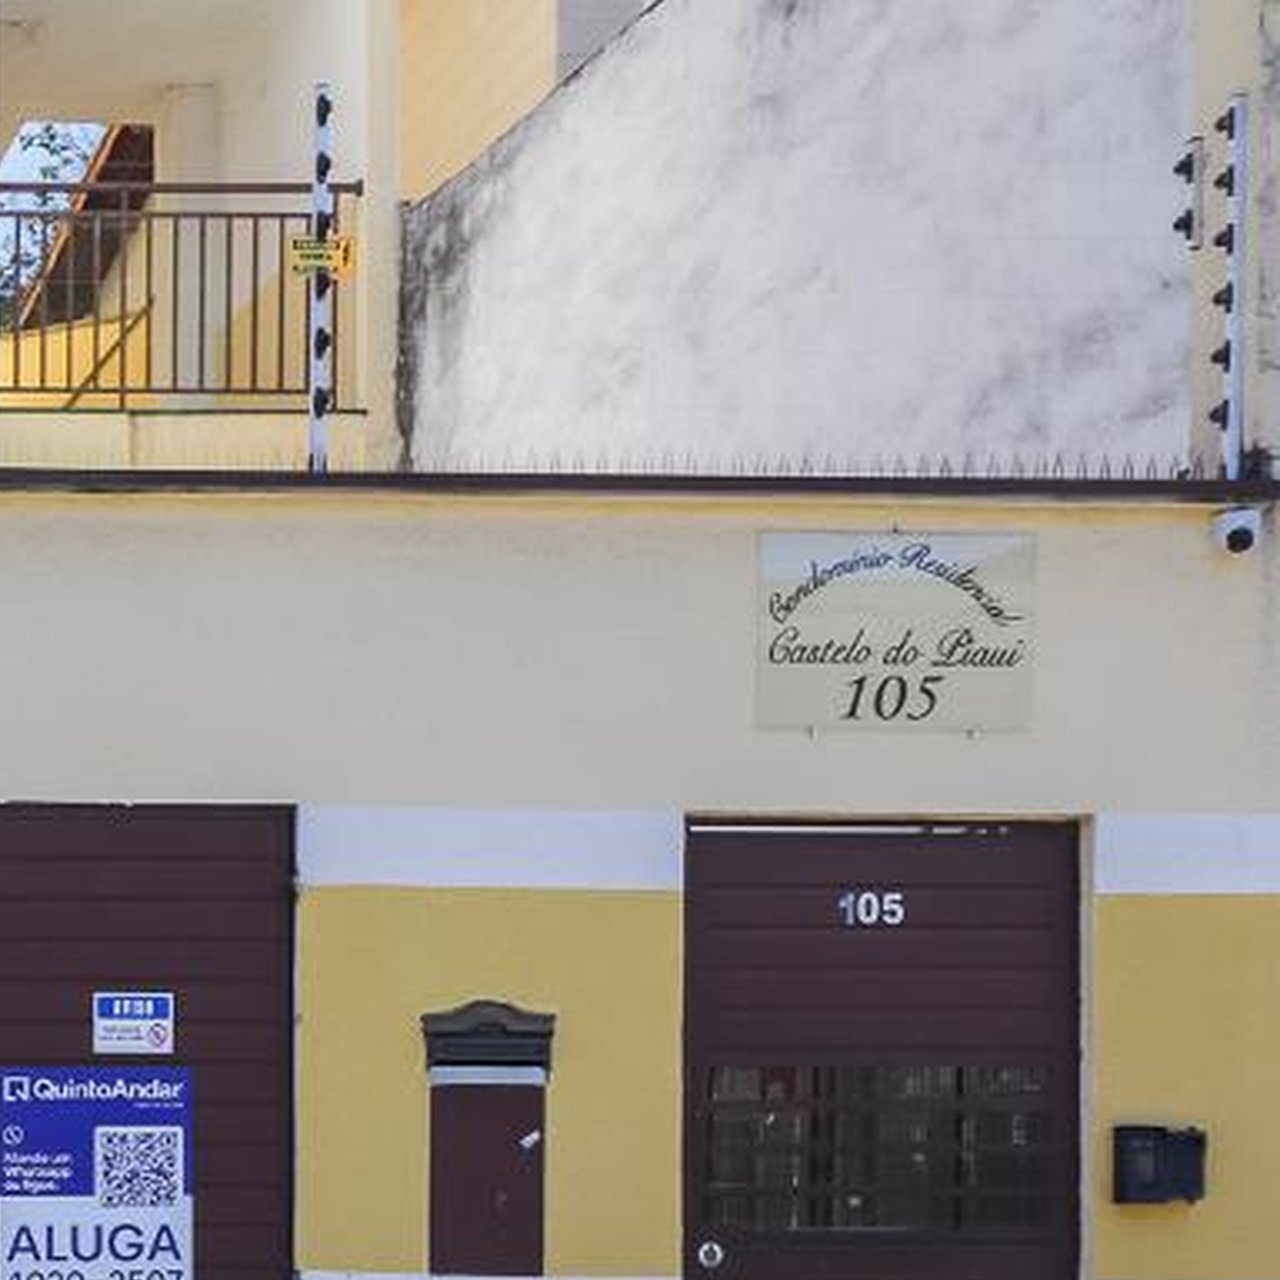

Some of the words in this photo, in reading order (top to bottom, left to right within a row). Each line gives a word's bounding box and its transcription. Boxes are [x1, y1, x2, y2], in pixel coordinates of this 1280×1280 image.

[768, 626, 871, 665] Castelo
[881, 628, 924, 667] do
[840, 674, 945, 721] 105
[838, 891, 905, 925] 105
[33, 1077, 185, 1100] QuintoAndar
[7, 1223, 182, 1262] ALUGA
